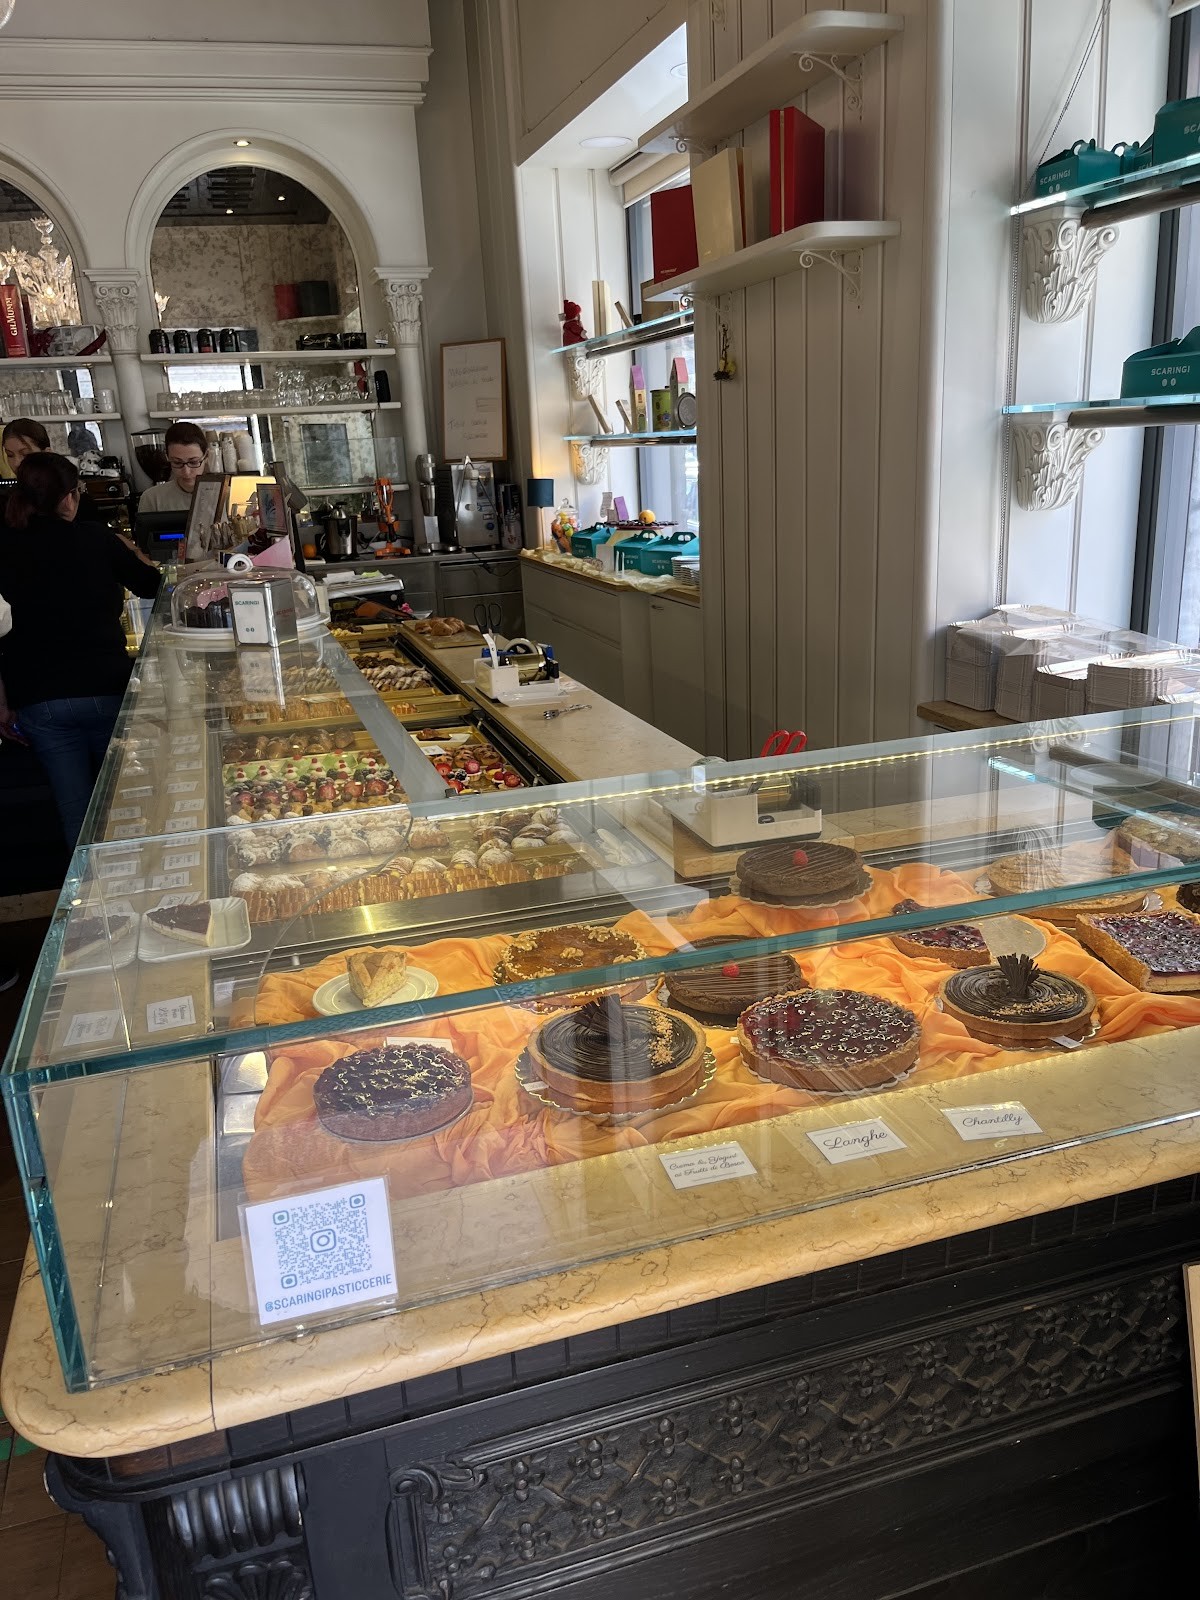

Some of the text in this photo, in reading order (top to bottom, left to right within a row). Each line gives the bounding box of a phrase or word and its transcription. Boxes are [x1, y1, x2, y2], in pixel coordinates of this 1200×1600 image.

[1039, 169, 1071, 186] SCARINGI
[1150, 365, 1191, 376] SCARINGI
[962, 1113, 1023, 1127] Chantilly
[823, 1129, 888, 1150] Langhe
[669, 1162, 696, 1171] Crema
[708, 1153, 737, 1165] Yogurt
[684, 1168, 709, 1176] Frutti
[719, 1161, 745, 1169] Bosco
[265, 1274, 392, 1312] @SCARINGIPASTICCERIE
